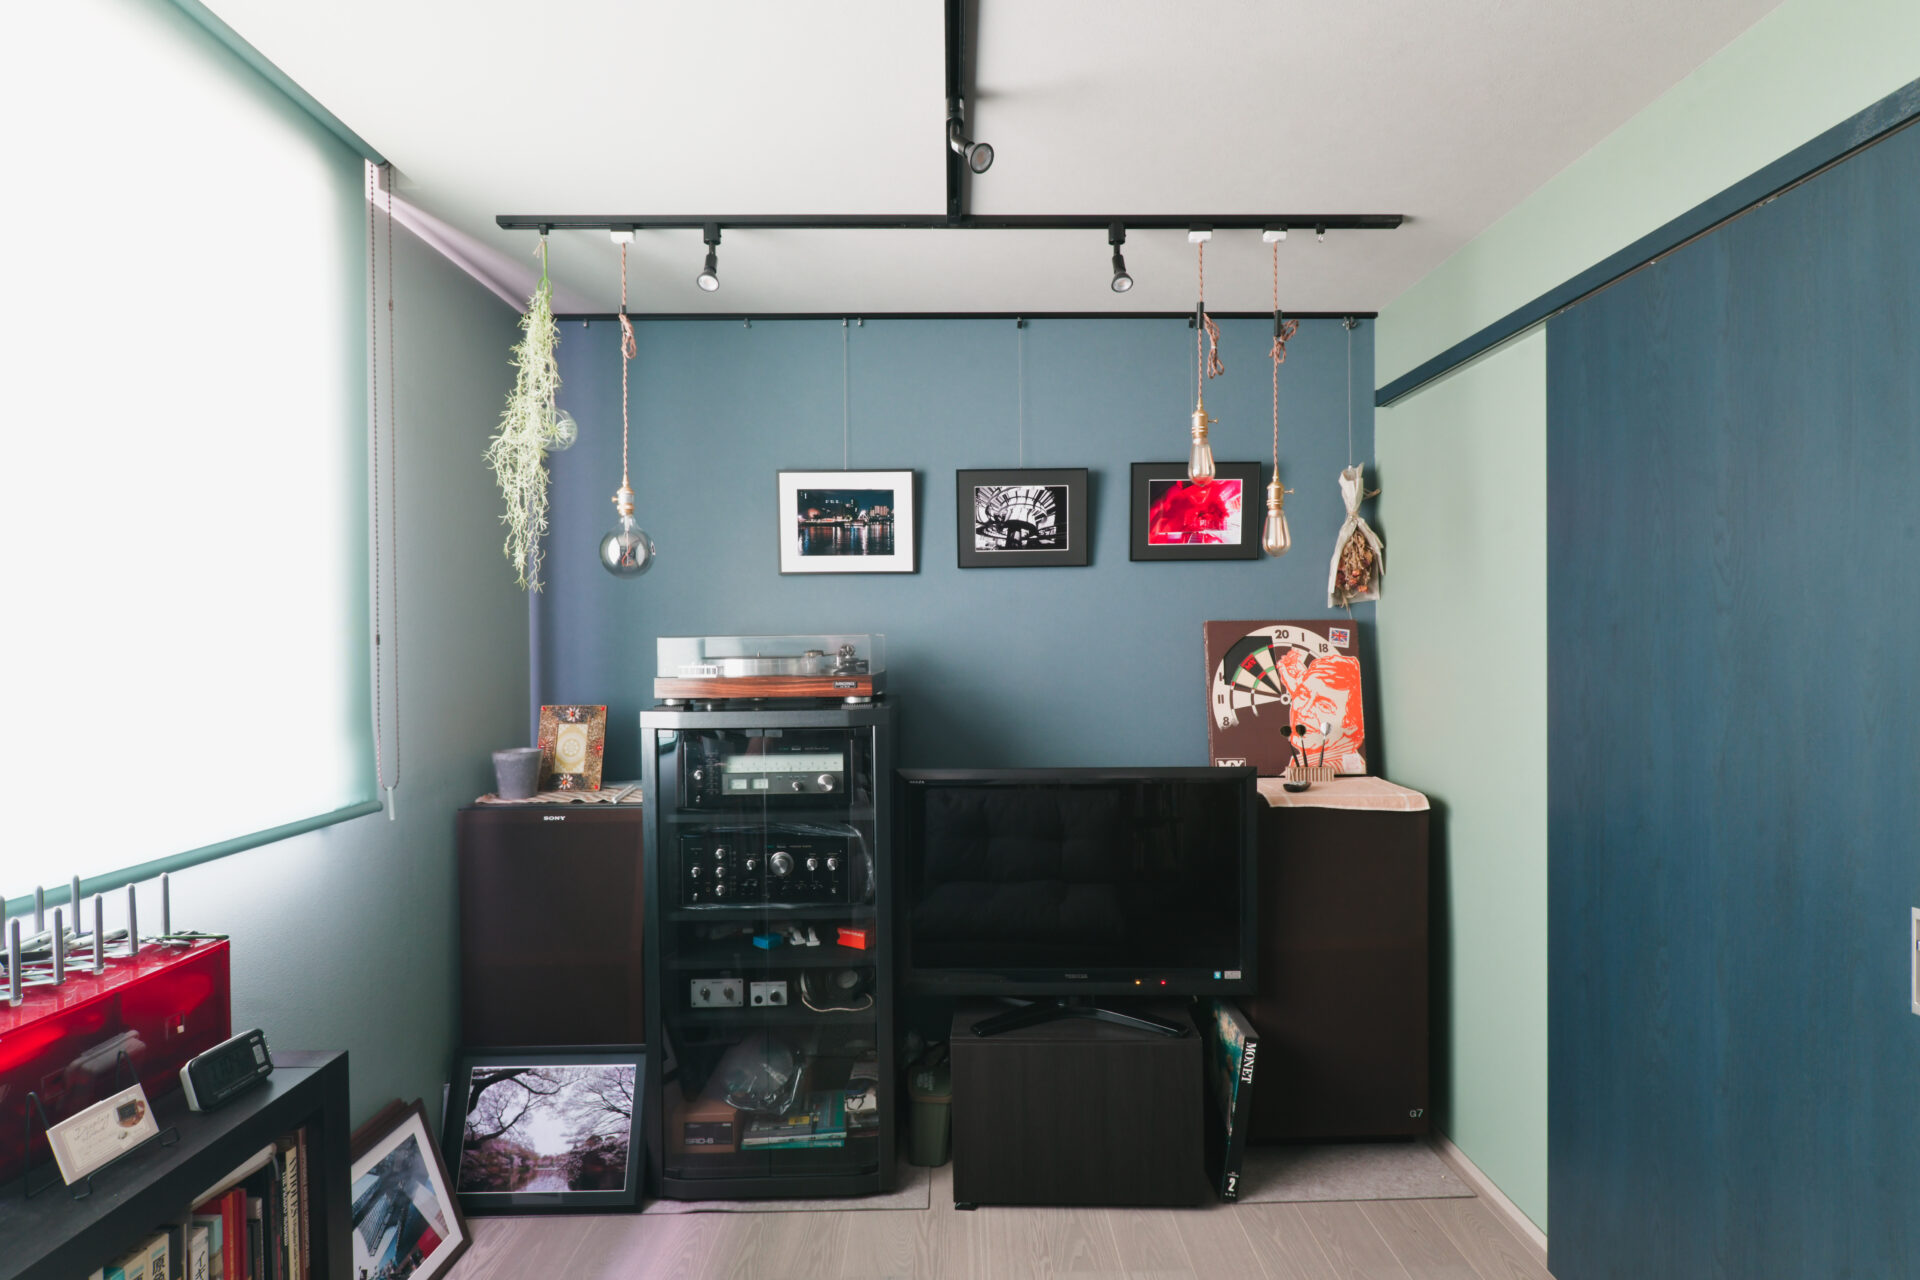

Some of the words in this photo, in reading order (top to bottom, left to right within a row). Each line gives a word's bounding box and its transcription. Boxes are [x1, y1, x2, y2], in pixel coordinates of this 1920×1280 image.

[1275, 629, 1289, 639] 20
[1319, 643, 1329, 653] 18
[1217, 694, 1225, 704] 11
[1222, 716, 1230, 726] 8
[1241, 1041, 1257, 1084] MONET
[1409, 1108, 1424, 1118] G7
[1227, 1177, 1236, 1192] 2
